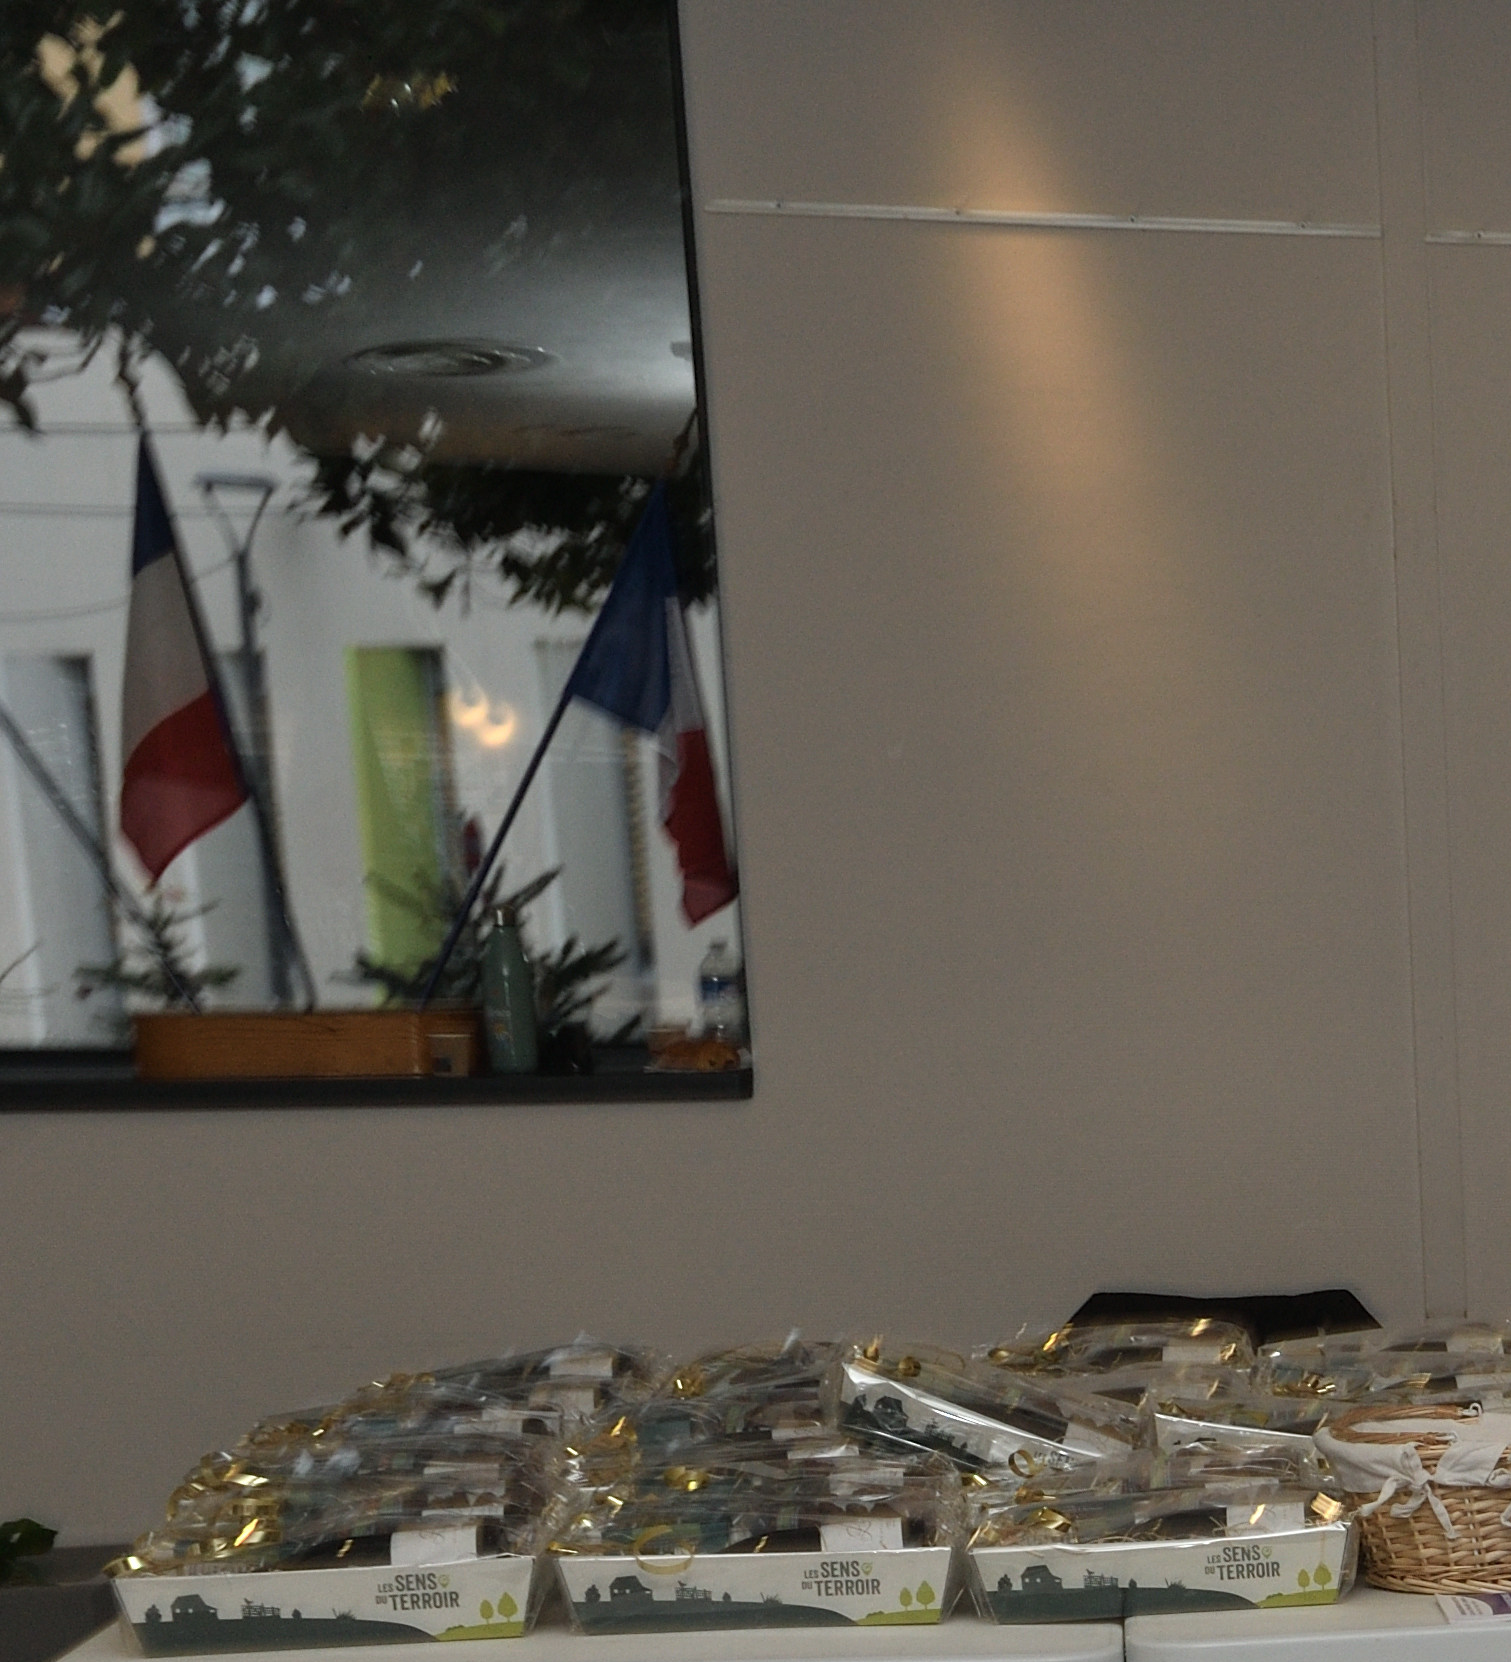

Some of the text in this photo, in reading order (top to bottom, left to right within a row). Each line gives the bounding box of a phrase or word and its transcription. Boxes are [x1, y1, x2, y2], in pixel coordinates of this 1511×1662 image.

[1207, 1545, 1261, 1564] LES SENS
[804, 1561, 860, 1579] LES SENS
[1205, 1562, 1280, 1581] DU TERROIR
[378, 1573, 437, 1593] LES SENS
[802, 1579, 880, 1596] DU TERROIR
[376, 1592, 460, 1610] DU TERROIR
